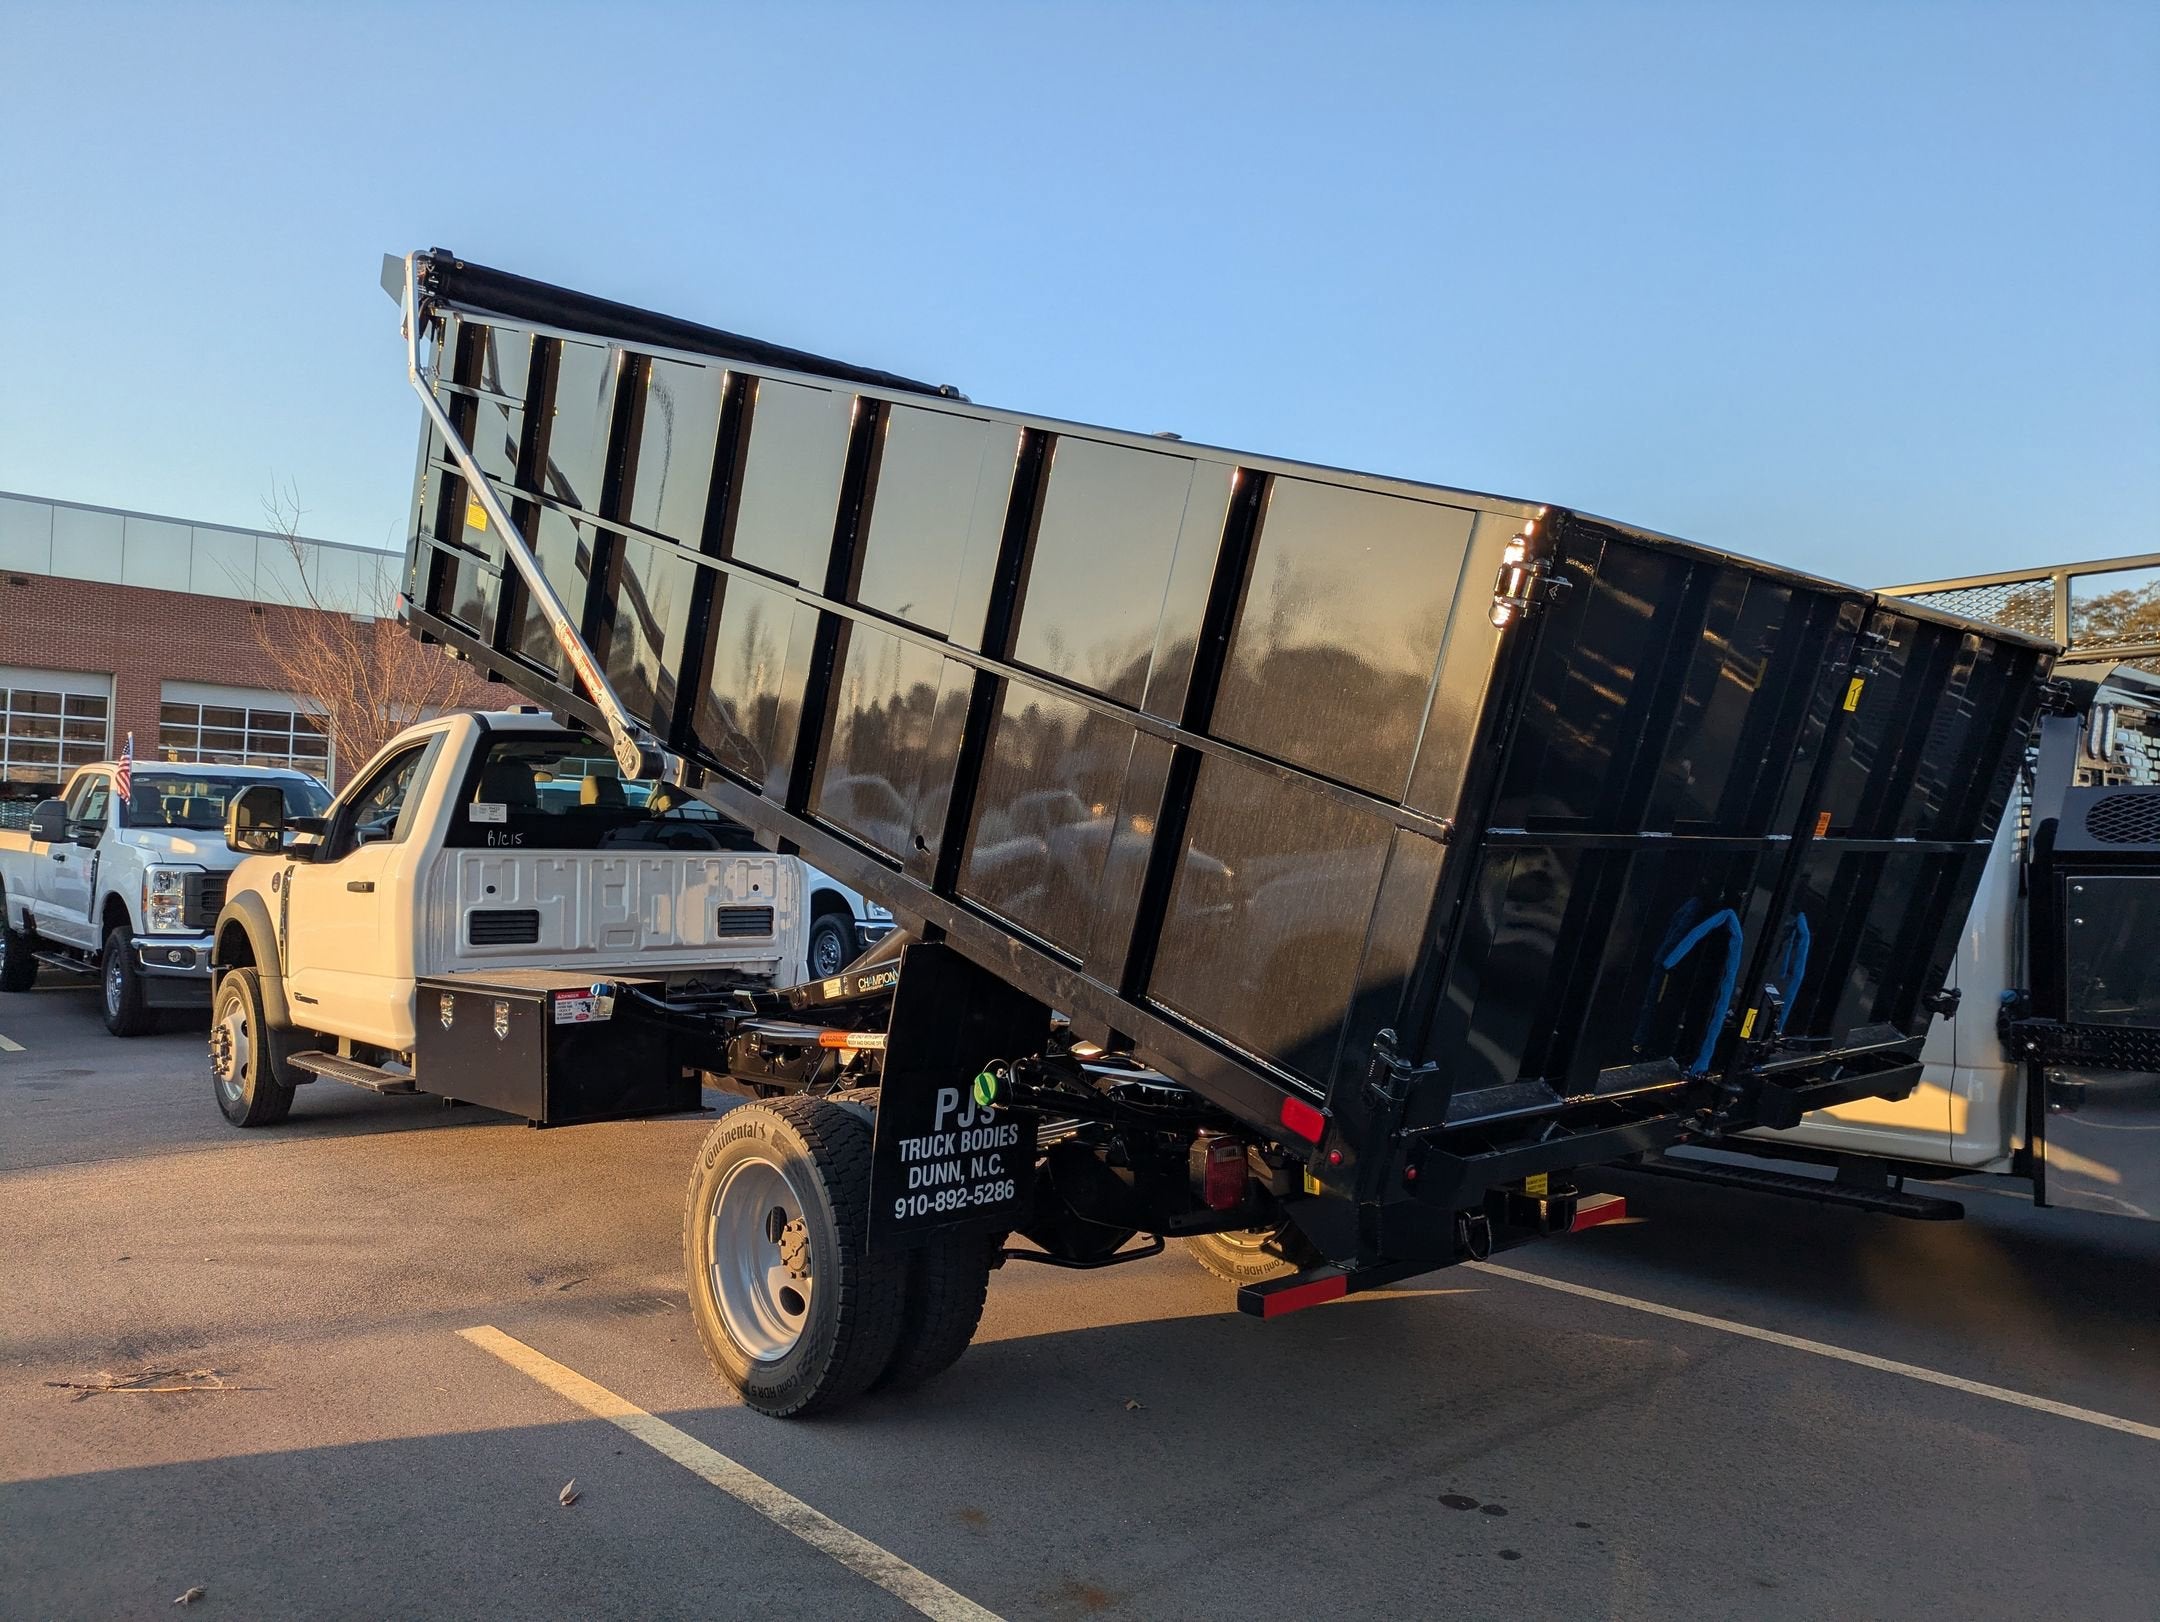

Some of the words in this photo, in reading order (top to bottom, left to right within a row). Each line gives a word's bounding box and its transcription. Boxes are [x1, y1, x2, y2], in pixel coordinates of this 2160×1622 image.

[858, 971, 897, 989] CHAMPION
[934, 1084, 995, 1131] PJs
[705, 1121, 758, 1169] Continental
[899, 1132, 956, 1162] TRUCK
[960, 1123, 1019, 1153] BODIES
[908, 1160, 965, 1189] DUNN,
[970, 1154, 1005, 1179] N.C.
[894, 1179, 1015, 1219] 910-892-5286
[757, 1386, 777, 1399] HDR
